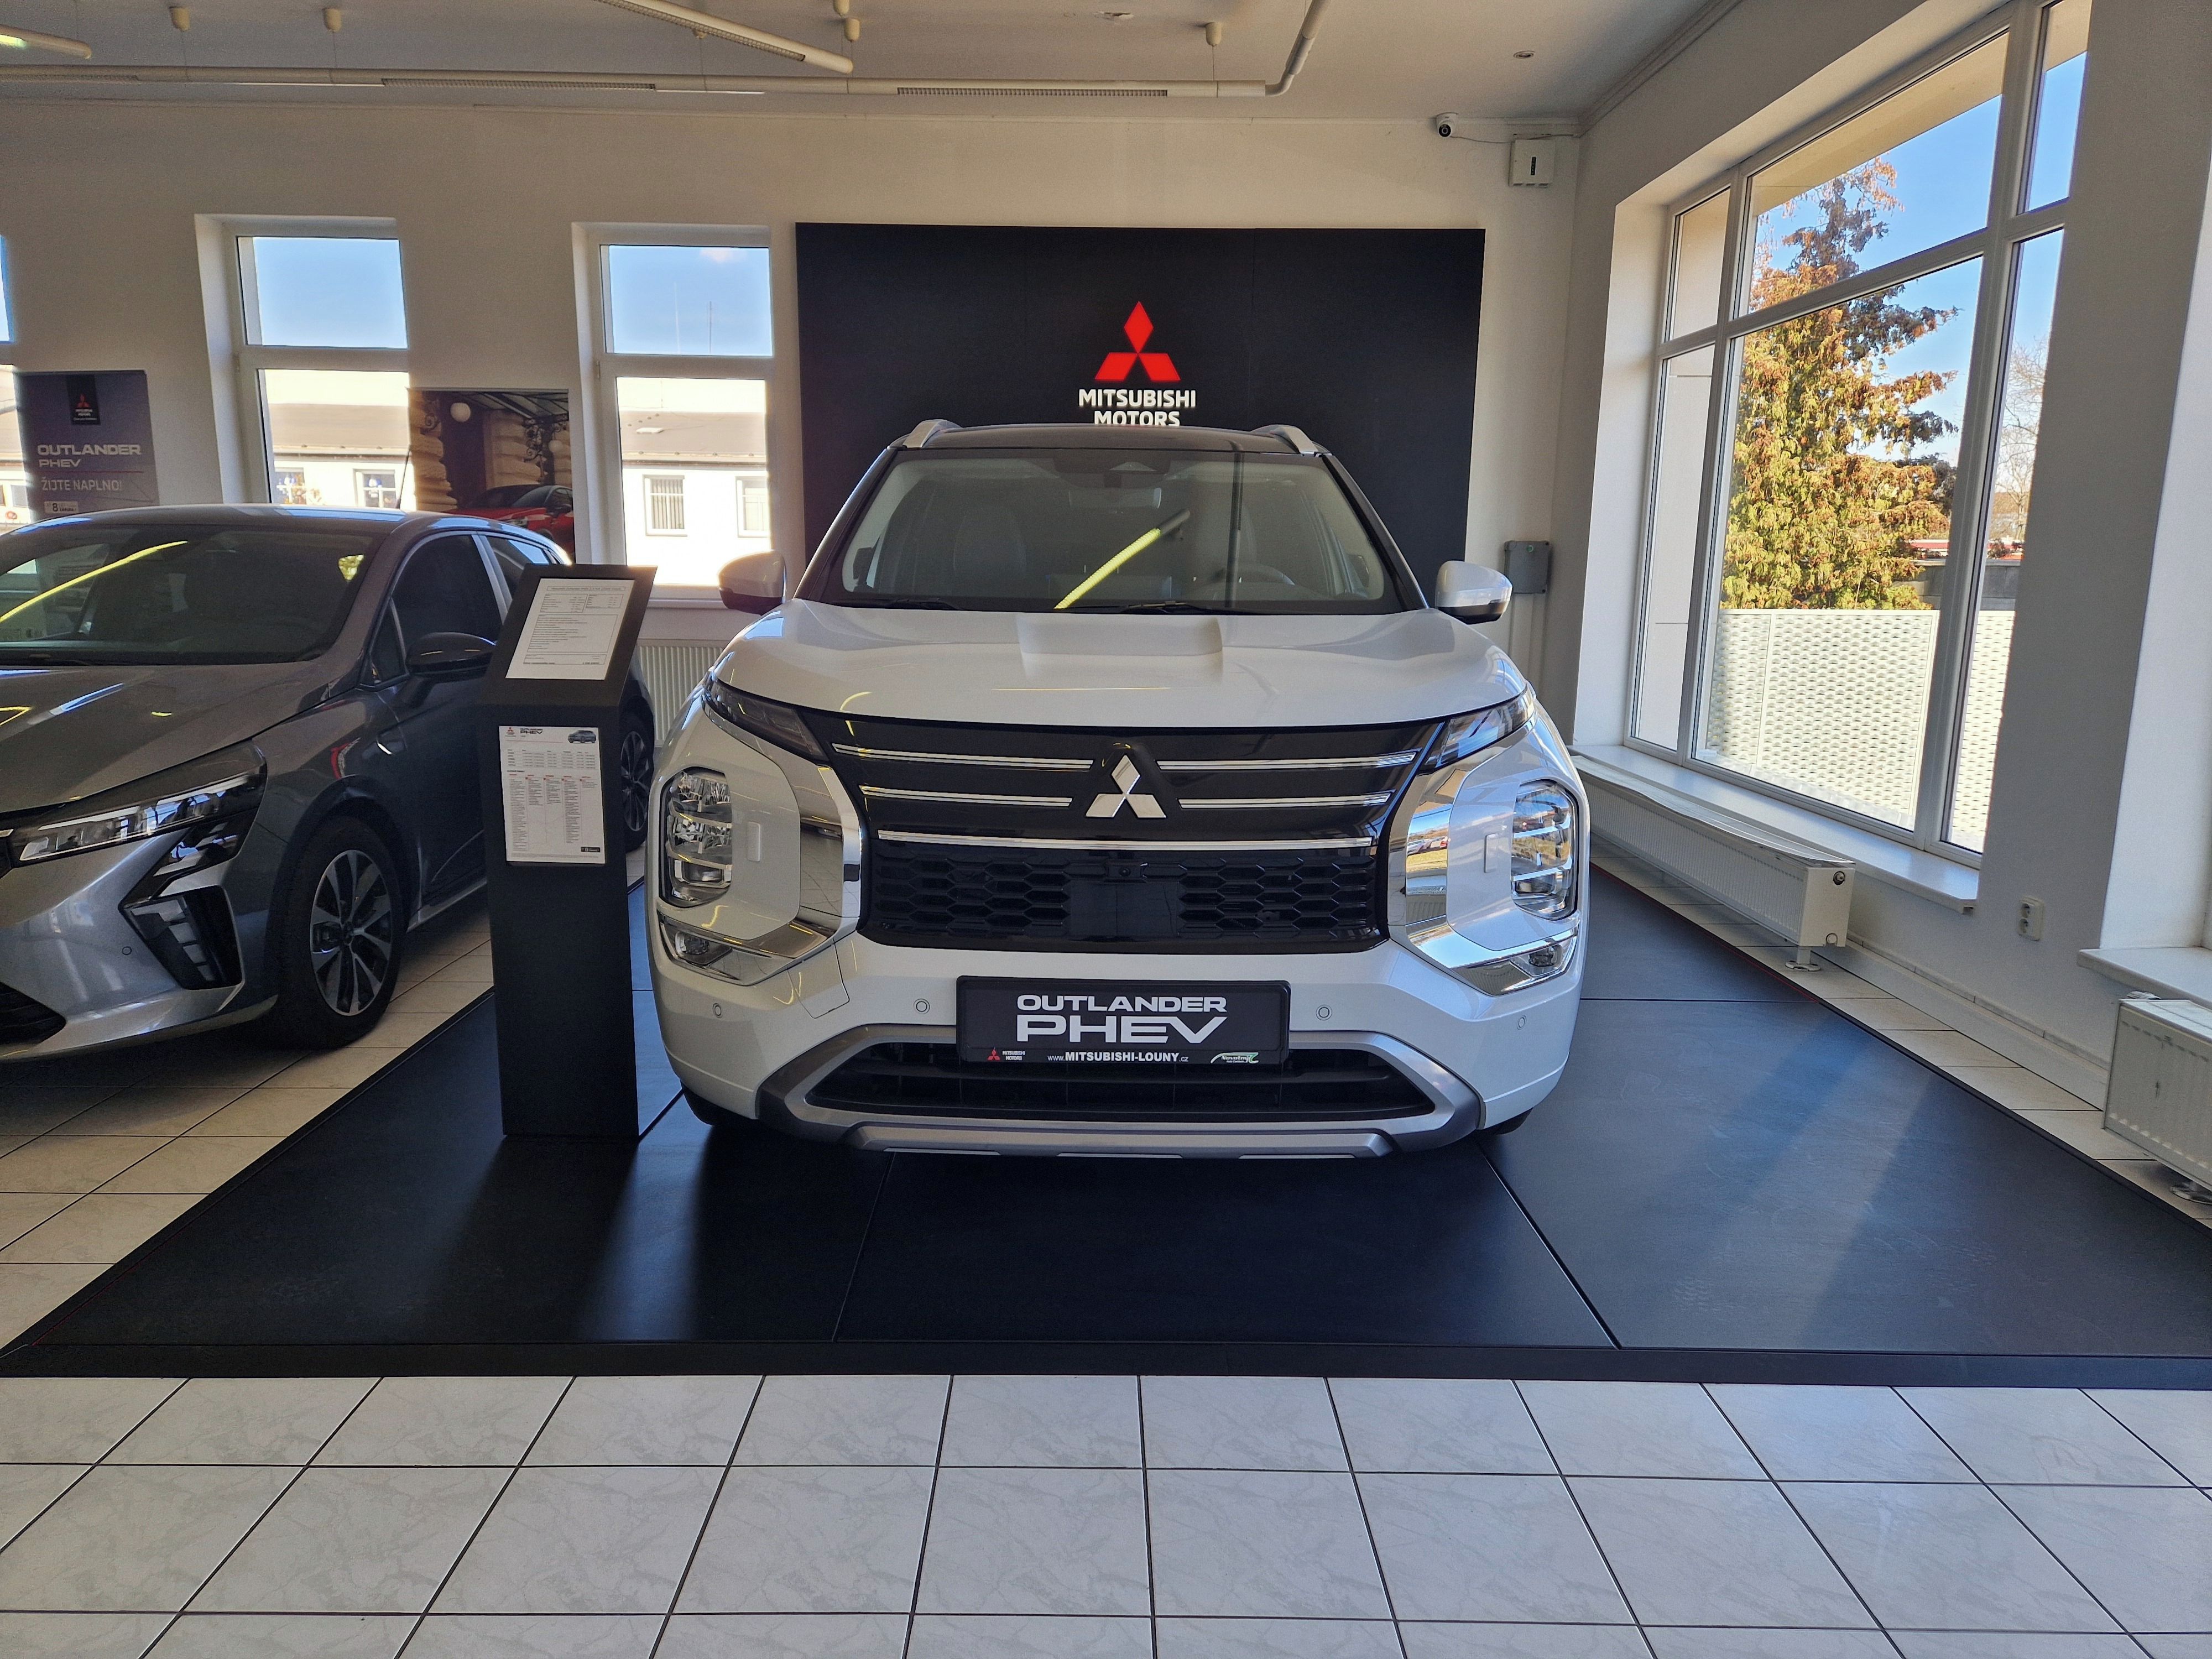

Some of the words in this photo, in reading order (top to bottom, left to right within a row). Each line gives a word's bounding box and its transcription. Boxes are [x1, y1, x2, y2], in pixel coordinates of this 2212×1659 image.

[1079, 389, 1196, 407] MITSUBISHI
[1094, 410, 1180, 426] MOTORS
[37, 444, 142, 455] OUTLANDER
[39, 458, 81, 467] PHEV
[41, 476, 71, 491] ŽIJTE
[73, 479, 122, 491] NAPLNO!
[53, 503, 58, 512] 8
[1017, 994, 1227, 1013] OUTLANDER
[1016, 1014, 1228, 1044] PHEV
